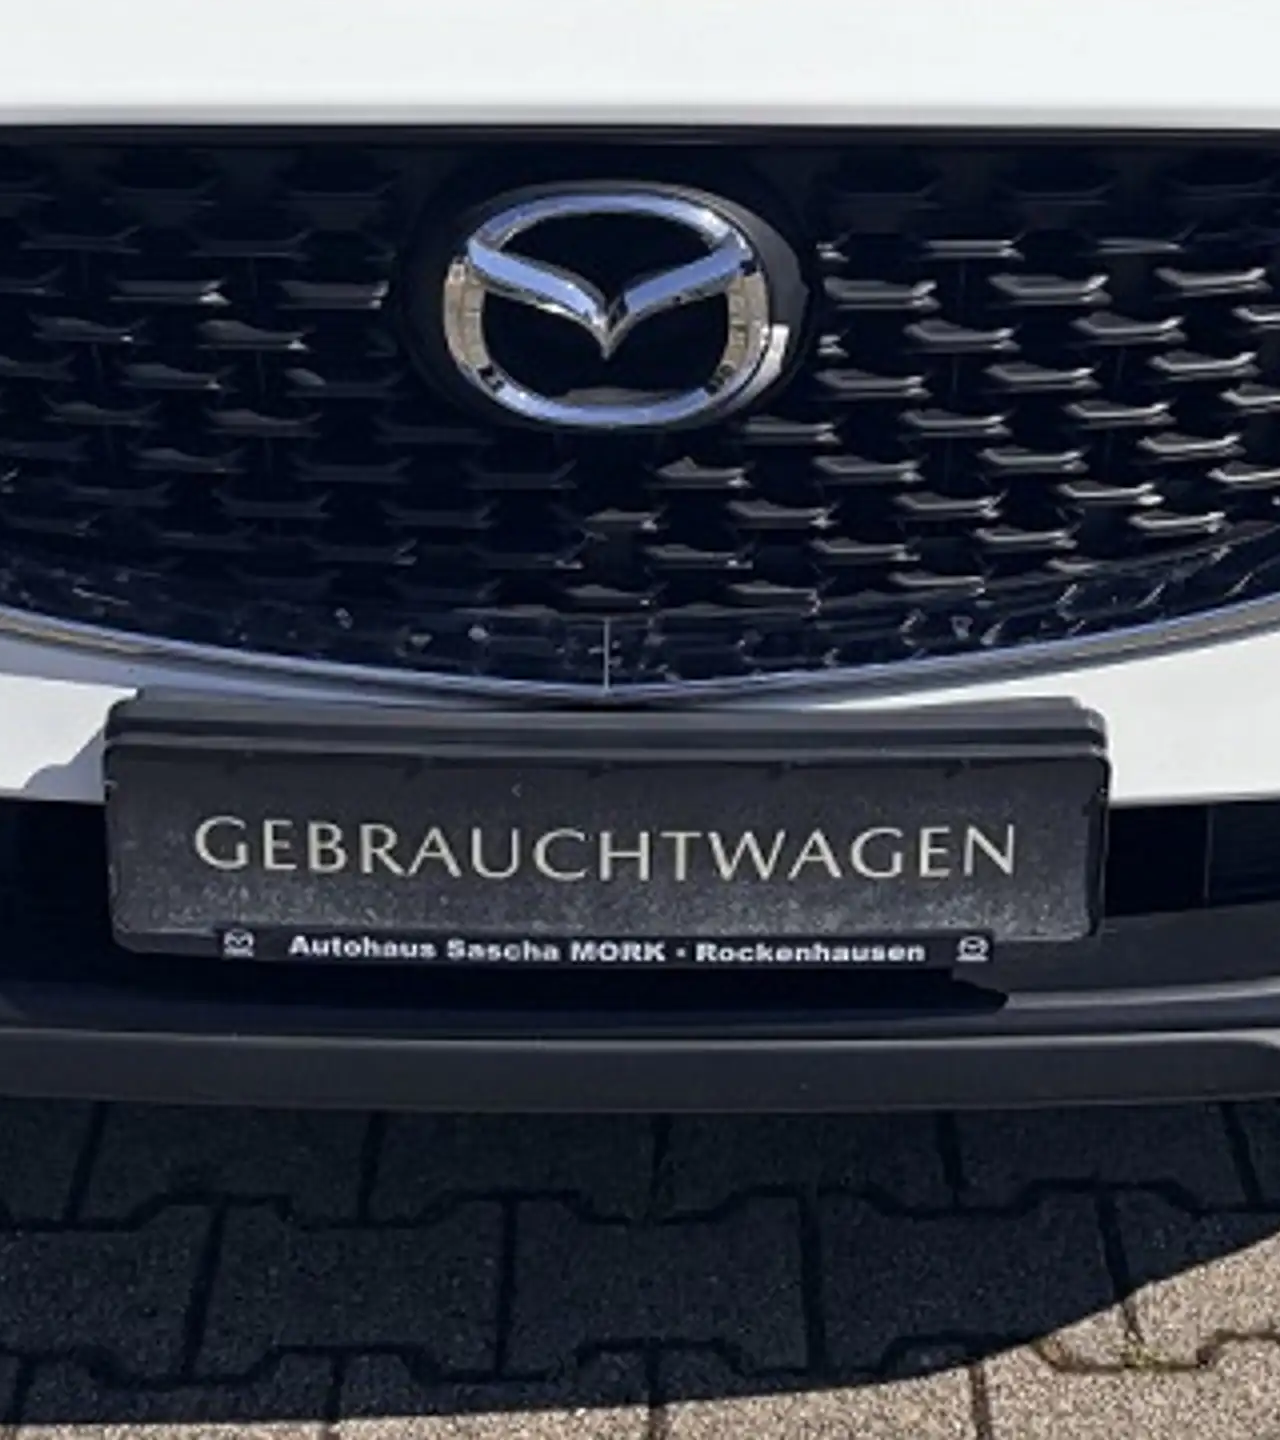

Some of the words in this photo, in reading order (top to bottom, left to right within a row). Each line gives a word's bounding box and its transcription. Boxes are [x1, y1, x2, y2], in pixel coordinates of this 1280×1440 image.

[193, 814, 1018, 883] GEBRAUCHTWAGEN
[288, 934, 438, 959] Autohaus
[446, 937, 561, 963] Sascha
[570, 940, 666, 963] MORK
[695, 941, 926, 963] Rockenhausen
